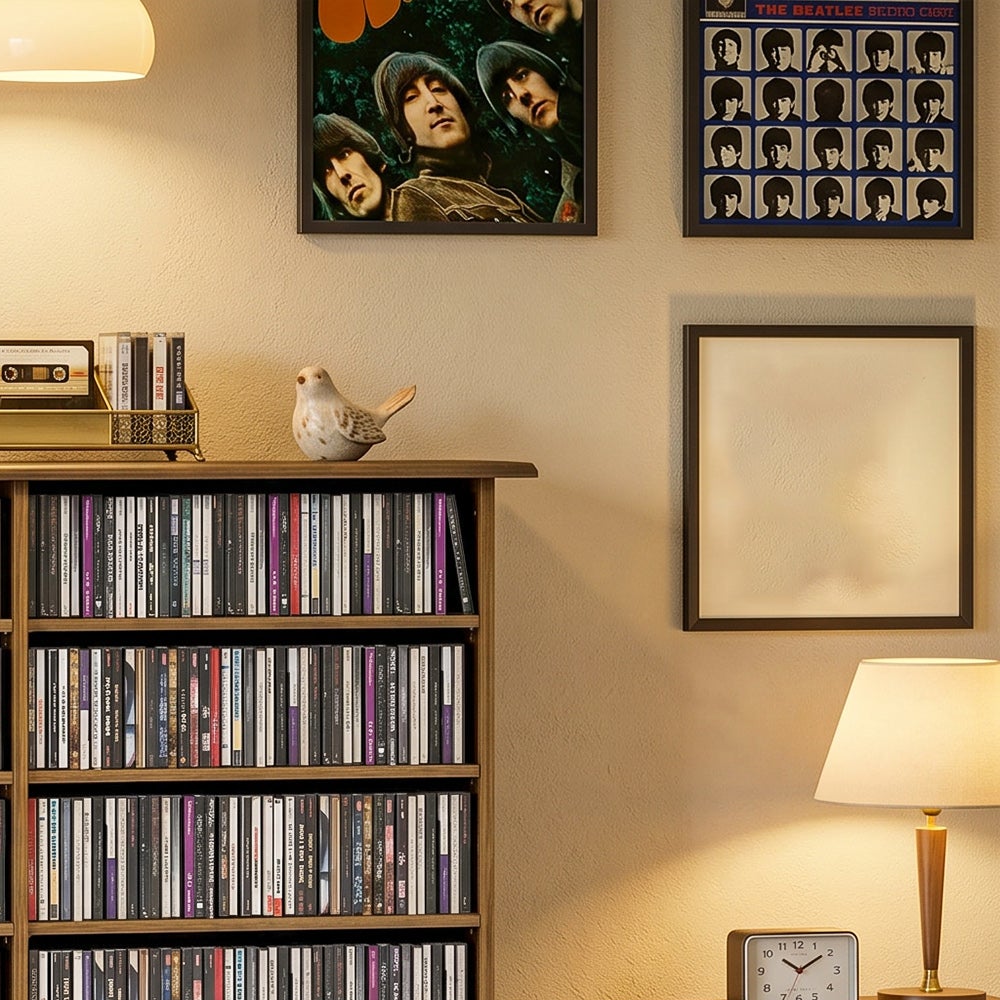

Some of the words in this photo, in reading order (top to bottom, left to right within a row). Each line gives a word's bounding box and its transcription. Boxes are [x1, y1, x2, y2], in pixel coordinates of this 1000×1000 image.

[755, 5, 787, 15] THE
[778, 942, 787, 951] 11
[792, 940, 804, 950] 12
[812, 942, 817, 950] 1
[763, 949, 774, 958] 10
[827, 949, 834, 957] 2
[757, 966, 765, 976] 9
[833, 966, 841, 975] 3
[763, 983, 771, 993] 8
[826, 983, 834, 992] 4
